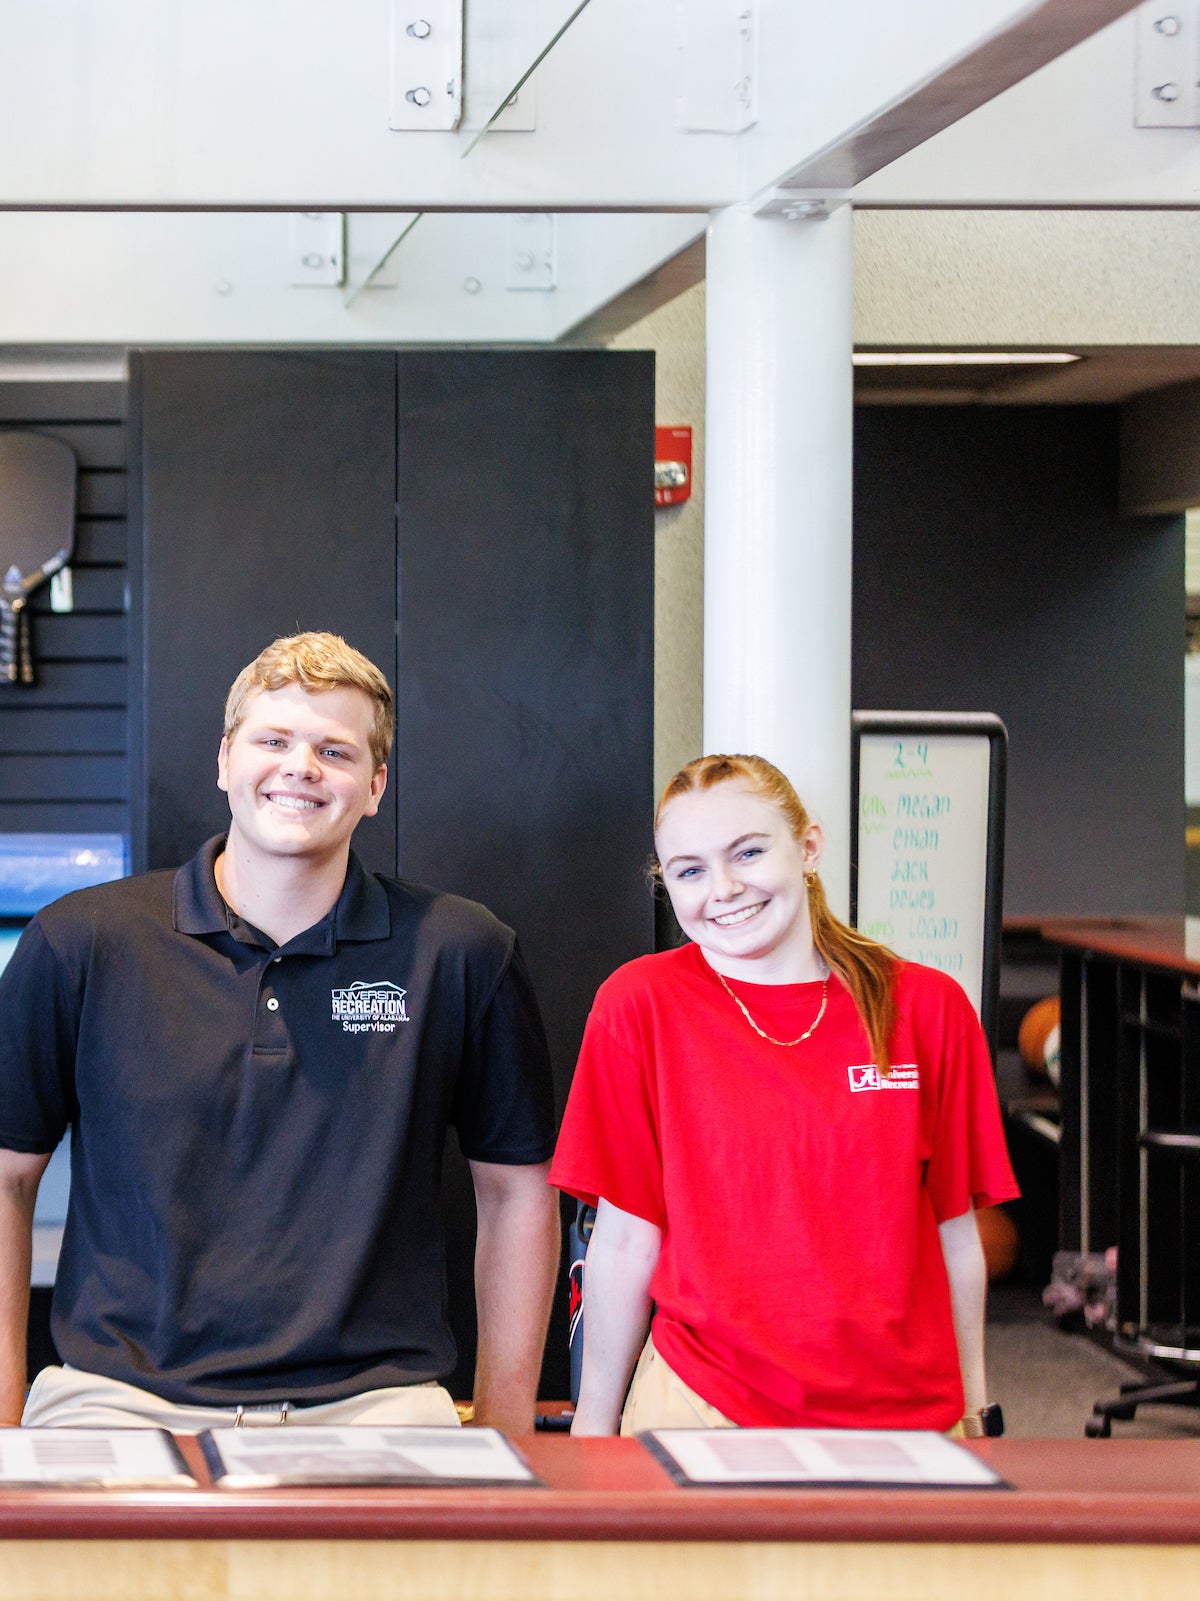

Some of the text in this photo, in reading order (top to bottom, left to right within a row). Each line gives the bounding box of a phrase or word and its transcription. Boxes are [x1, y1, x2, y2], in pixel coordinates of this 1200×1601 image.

[332, 990, 406, 1000] UNIVERSITY
[331, 999, 406, 1014] RECREATION
[342, 1021, 396, 1034] Supervisor
